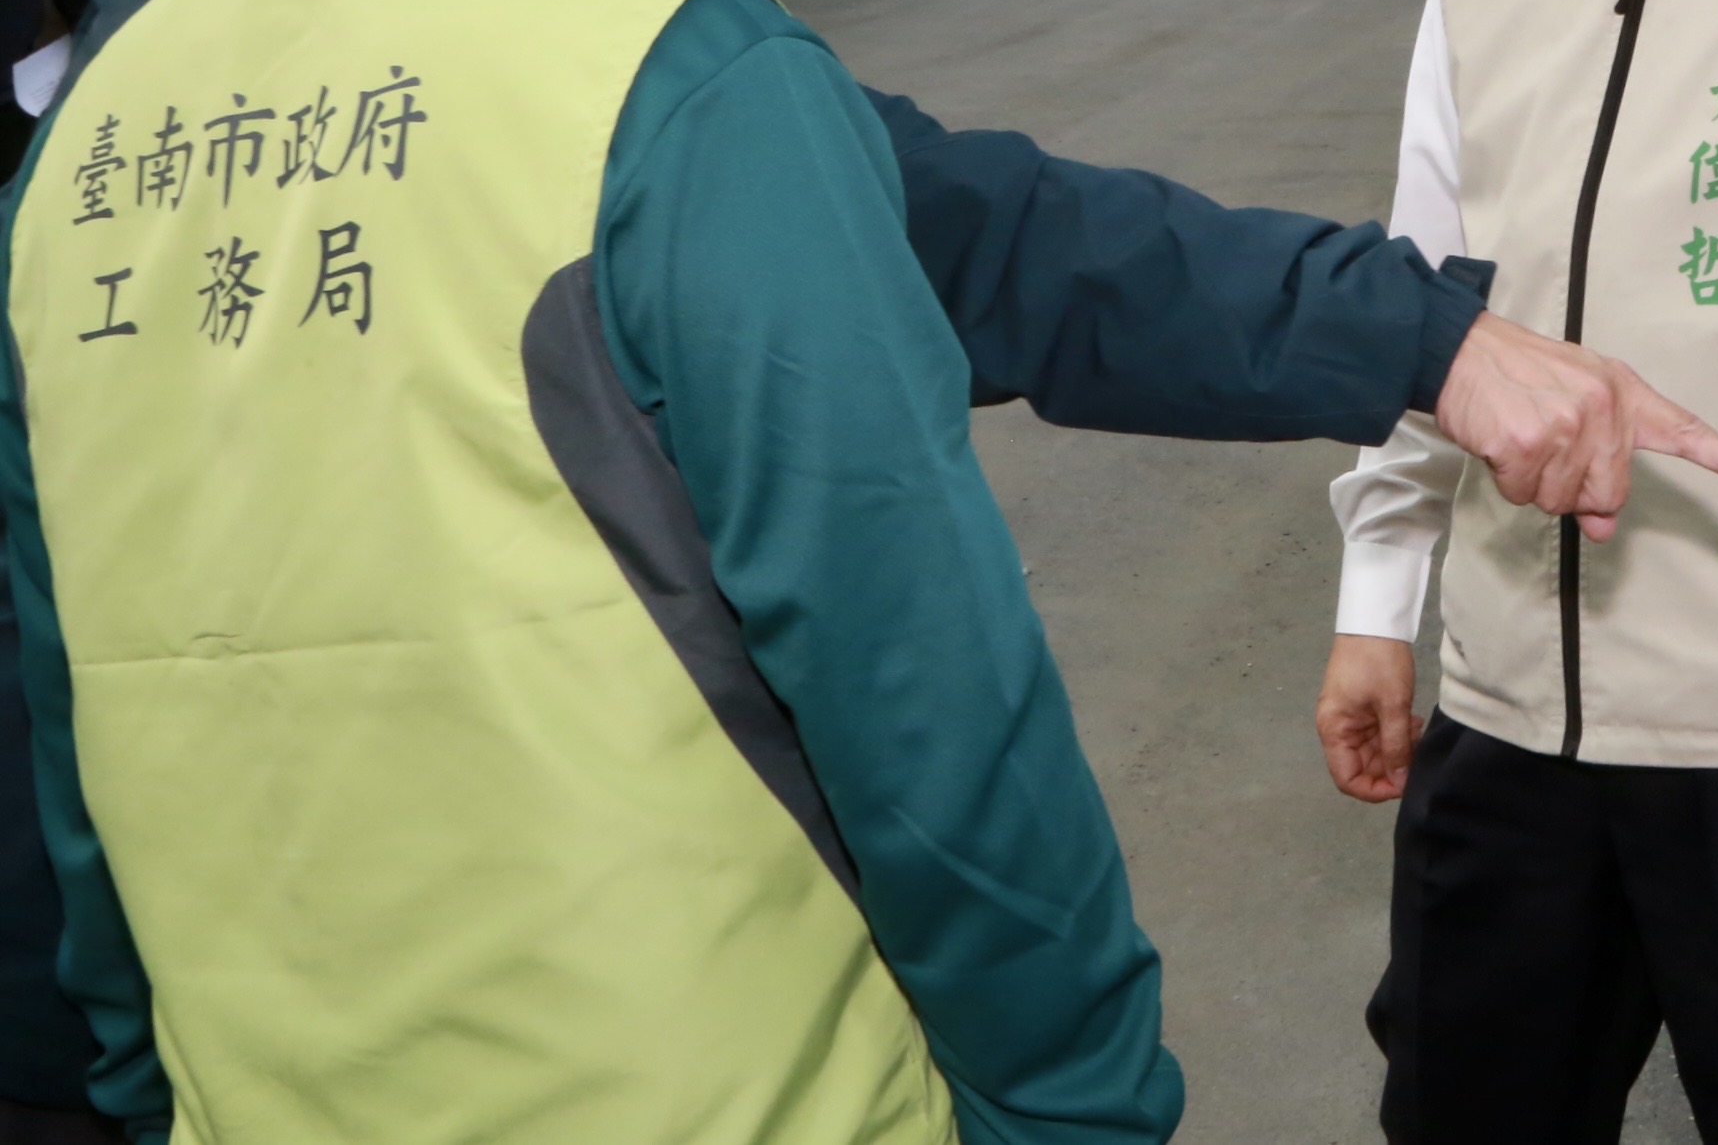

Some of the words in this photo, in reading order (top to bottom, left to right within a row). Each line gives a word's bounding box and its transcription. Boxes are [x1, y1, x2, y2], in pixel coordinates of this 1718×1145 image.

[72, 64, 428, 226] 臺南市政府
[77, 220, 374, 349] 工務局
